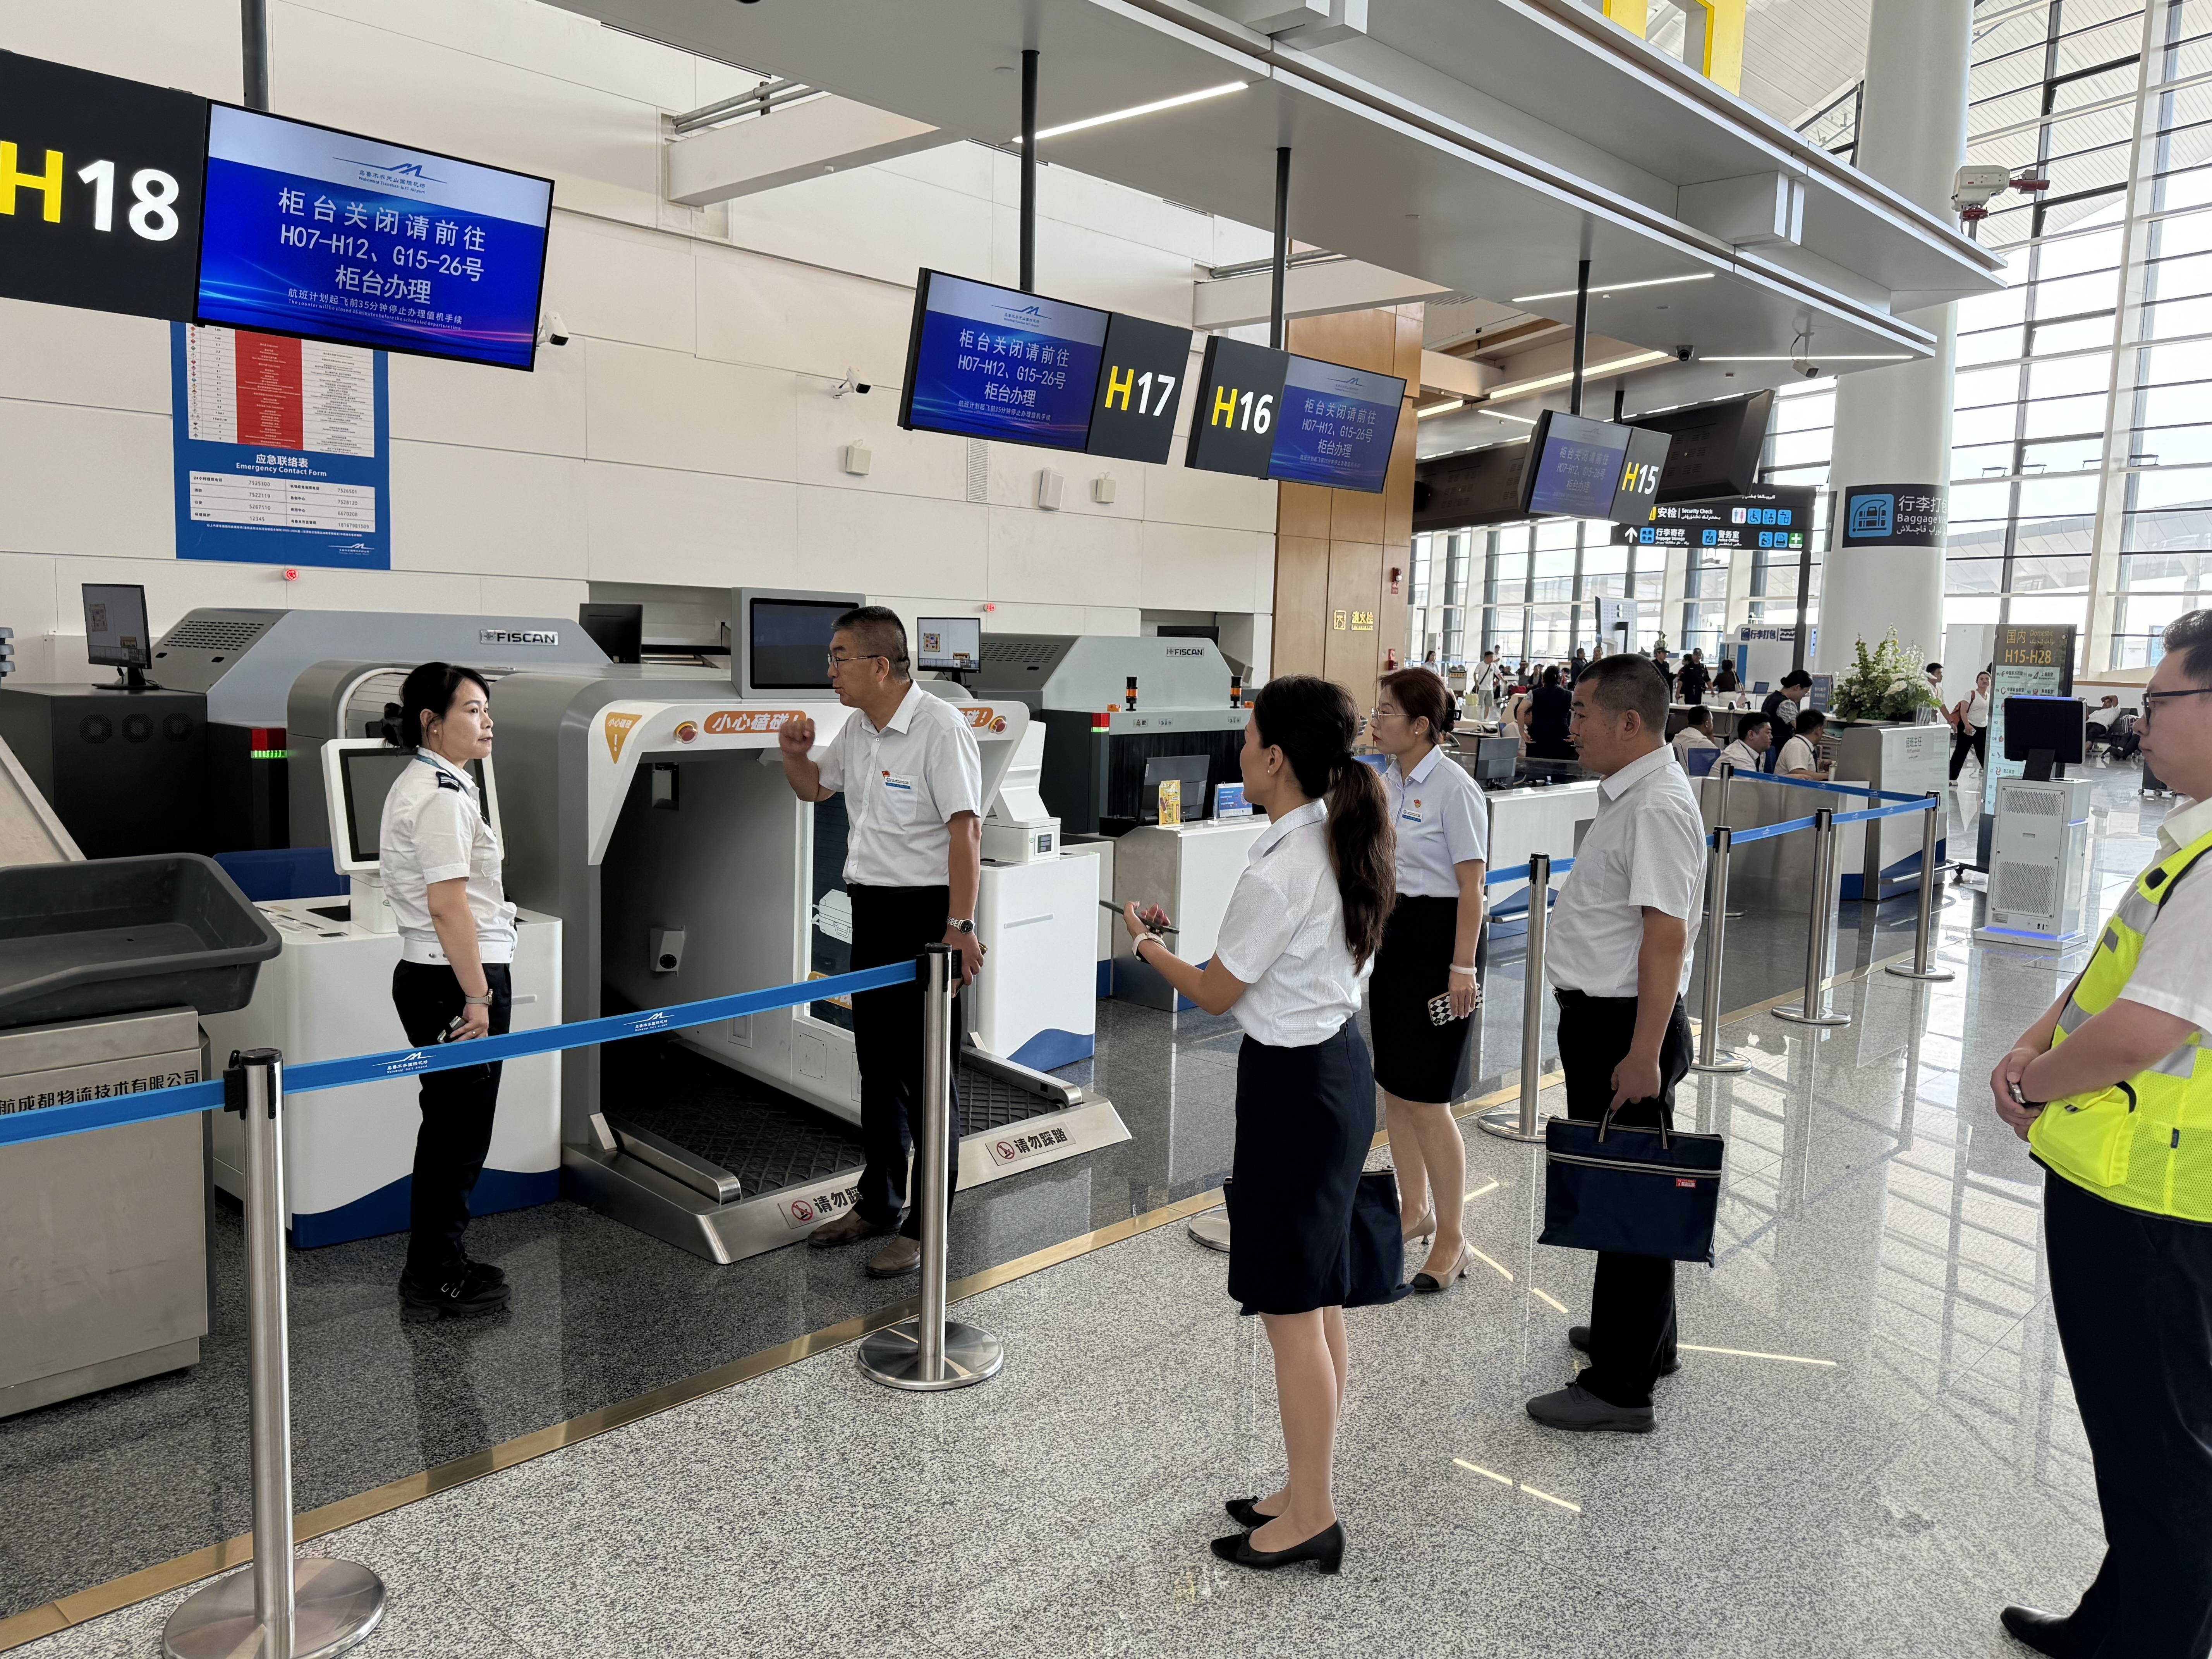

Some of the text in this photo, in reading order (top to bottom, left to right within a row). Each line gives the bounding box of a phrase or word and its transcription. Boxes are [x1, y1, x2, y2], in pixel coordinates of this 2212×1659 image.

[0, 141, 180, 242] H18
[278, 187, 486, 252] 柜台关闭请前往
[335, 264, 431, 304] 柜台办理
[288, 288, 462, 325] 航班计划起飞前35分钟停止办理值机手续
[960, 329, 1070, 367] 柜台关闭请前往
[984, 381, 1037, 407] 柜台办理
[1105, 366, 1176, 416] H17
[1211, 386, 1274, 434] H16
[1304, 398, 1377, 425] 柜台关闭请前往
[256, 453, 308, 468] 应急联络表
[1317, 439, 1352, 458] 柜台办理
[236, 462, 277, 474] Emergency
[278, 466, 307, 475] Contact
[1622, 462, 1659, 495] H15
[1657, 507, 1677, 518] 安检
[1897, 514, 1937, 525] Baggage
[1656, 528, 1685, 537] 行李寄存
[1718, 530, 1740, 539] 警务室
[497, 633, 555, 643] FISCAN
[1750, 630, 1776, 639] 行李打包
[2007, 629, 2026, 644] 国内
[2005, 649, 2051, 664] H15-H28
[1014, 1127, 1068, 1154] 请勿踩踏
[813, 1186, 864, 1214] 请勿踩
